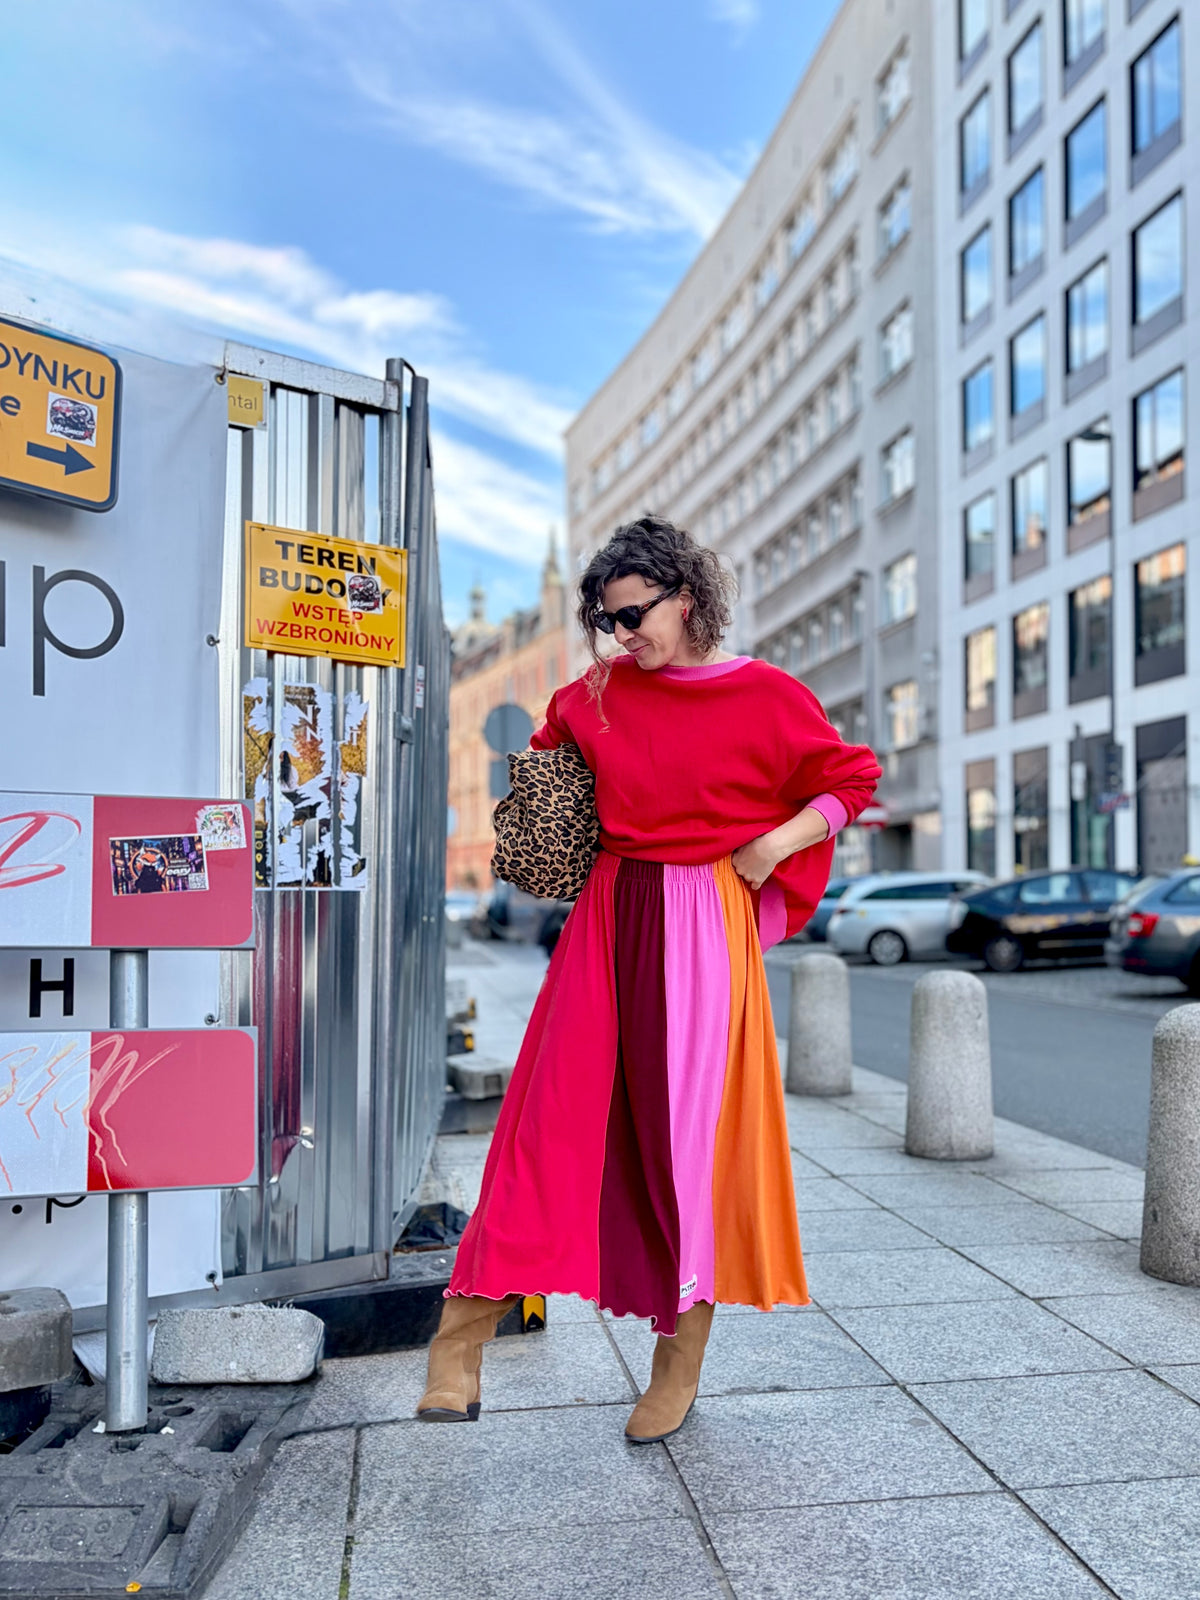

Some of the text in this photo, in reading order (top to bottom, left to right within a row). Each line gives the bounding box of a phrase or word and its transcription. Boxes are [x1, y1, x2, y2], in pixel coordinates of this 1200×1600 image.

[274, 539, 377, 577] TEREN
[259, 566, 392, 607] BUDOY
[292, 602, 363, 628] WSTĘP
[256, 618, 395, 651] WZBRONIONY
